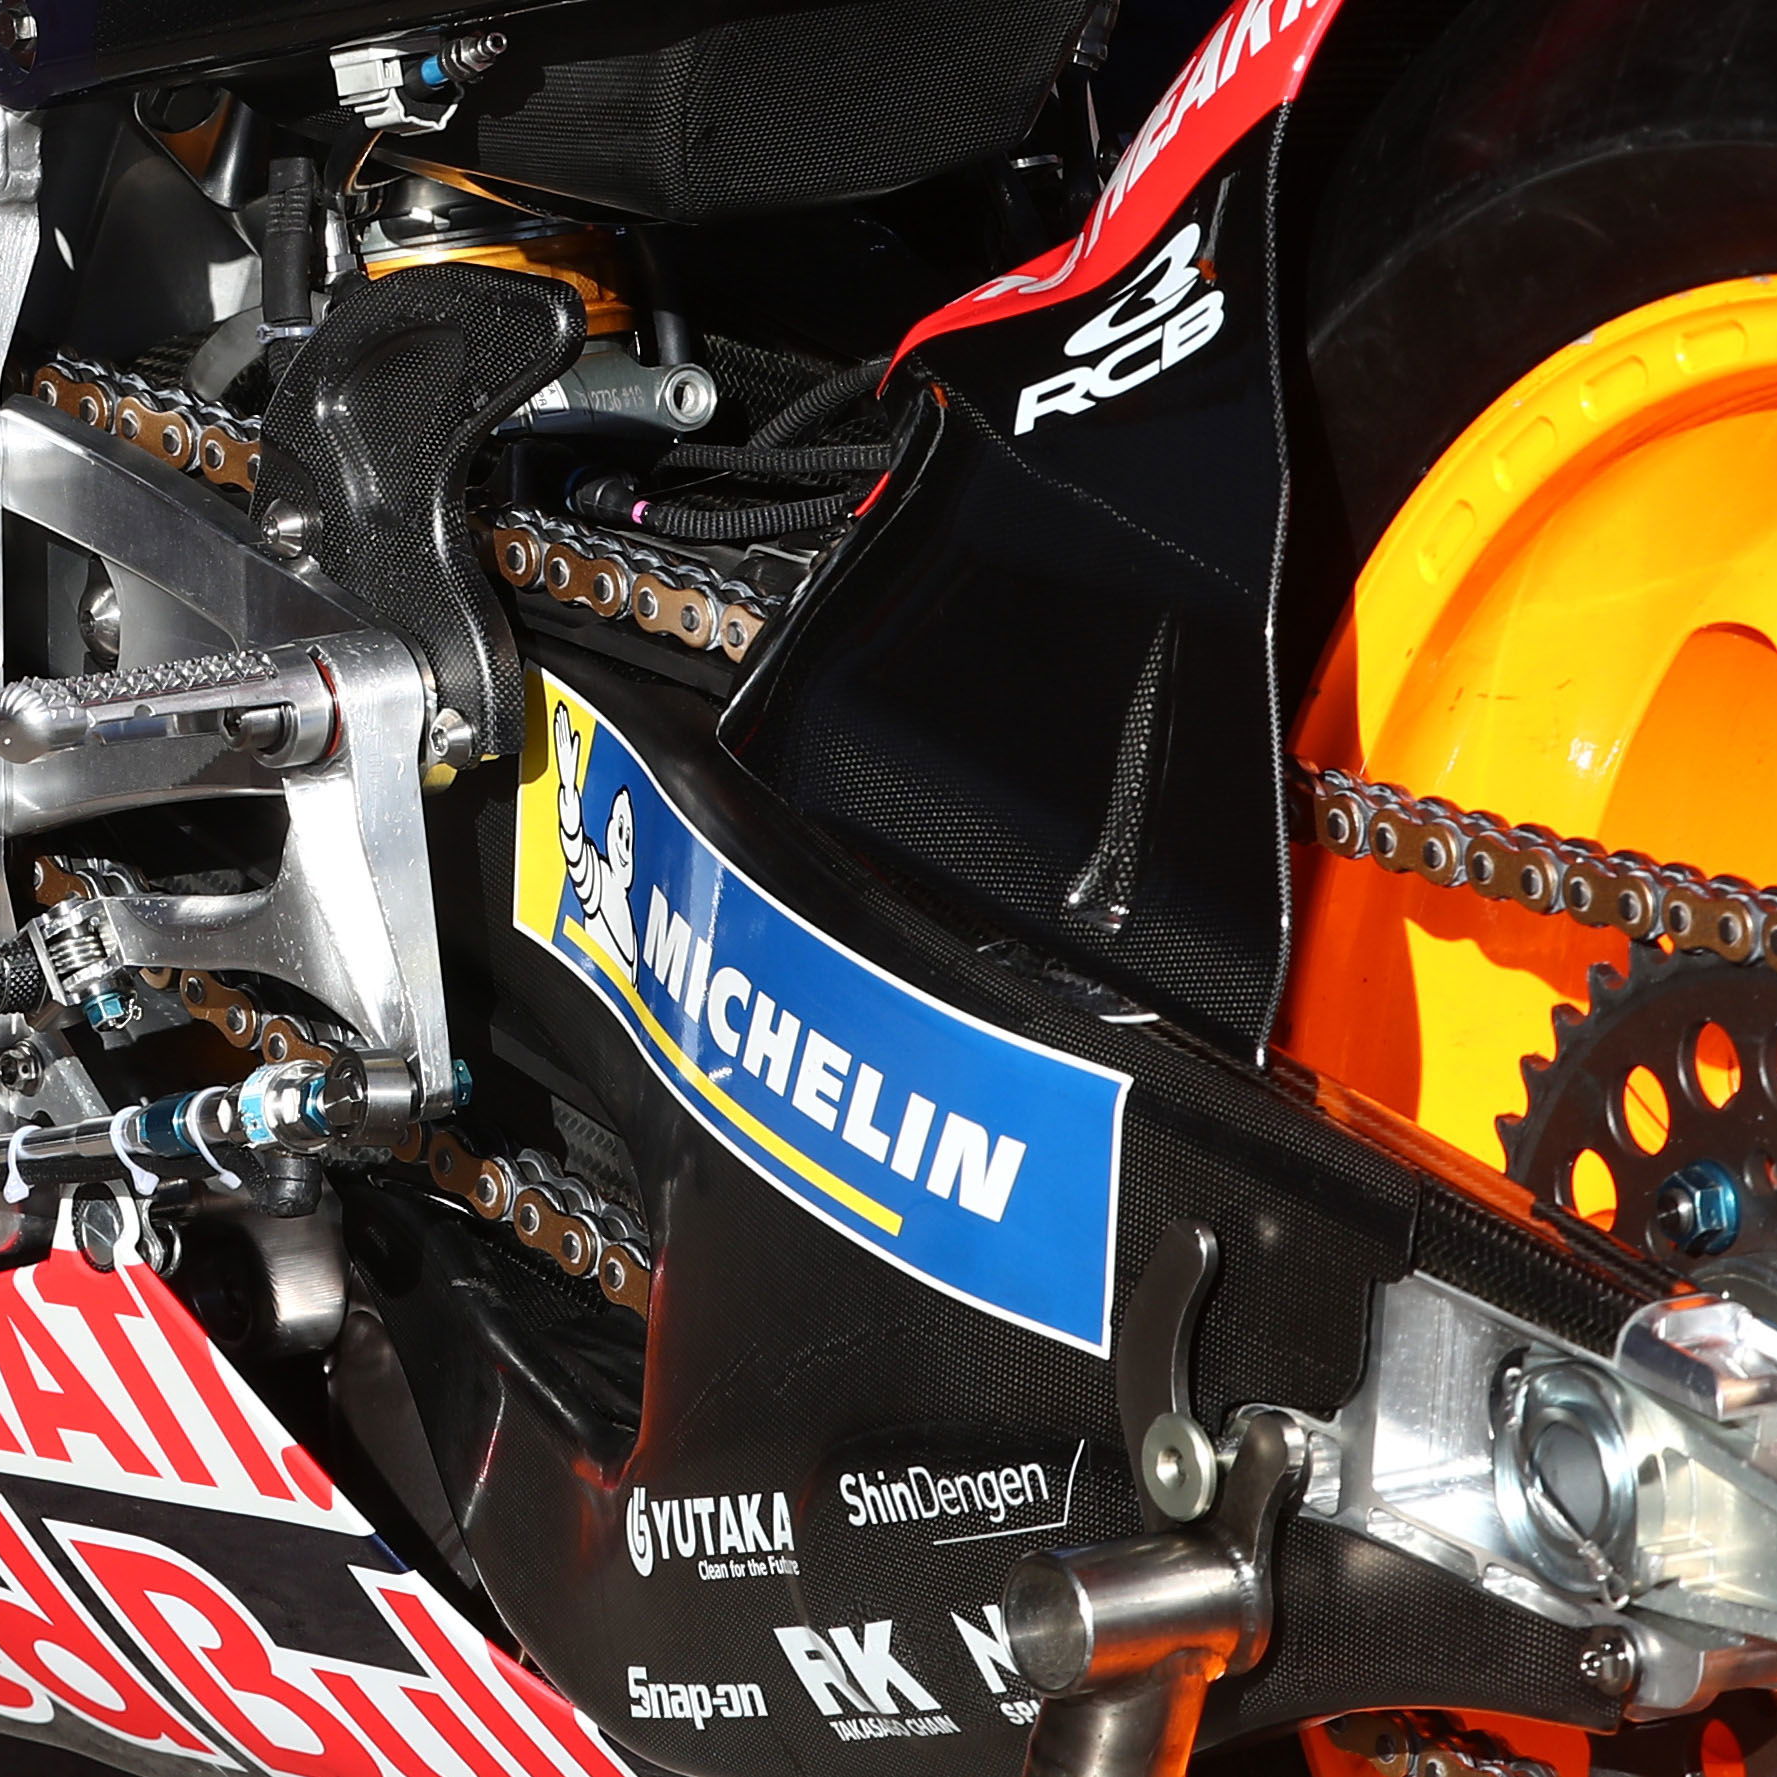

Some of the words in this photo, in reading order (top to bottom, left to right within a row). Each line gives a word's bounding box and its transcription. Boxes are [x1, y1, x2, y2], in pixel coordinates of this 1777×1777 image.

[1014, 290, 1224, 436] RCB
[643, 884, 1027, 1224] MICHELIN
[650, 1491, 795, 1560] YUTAKA
[839, 1463, 1049, 1527] ShinDengen
[698, 1559, 729, 1581] Clean
[729, 1559, 747, 1578] for
[747, 1557, 768, 1577] the
[627, 1666, 769, 1731] Snap-on
[773, 1619, 943, 1717] RK
[904, 1714, 962, 1737] CHAIN
